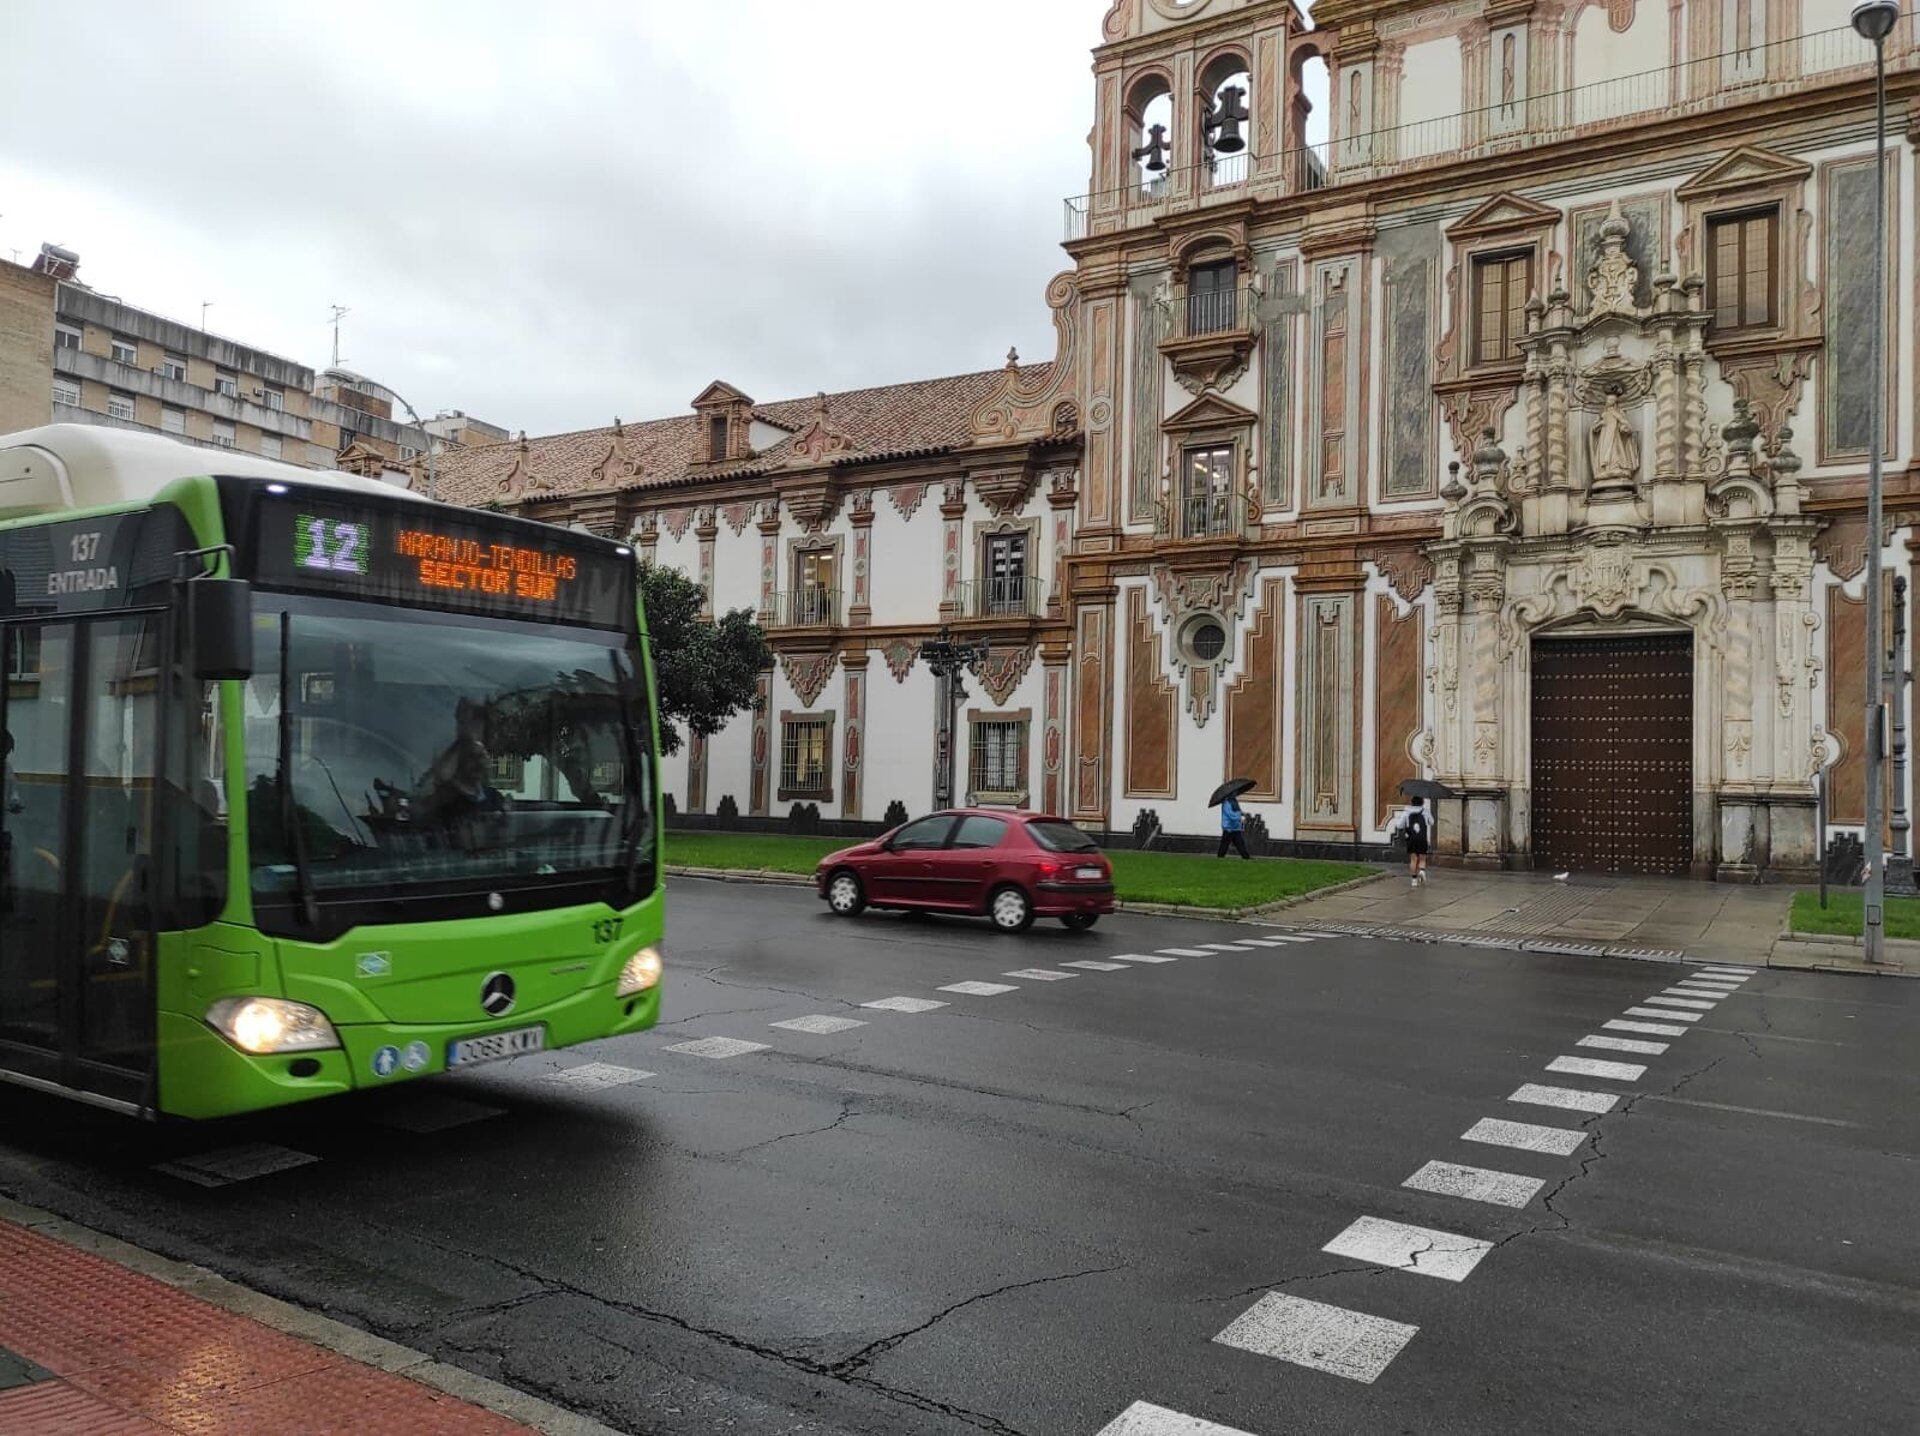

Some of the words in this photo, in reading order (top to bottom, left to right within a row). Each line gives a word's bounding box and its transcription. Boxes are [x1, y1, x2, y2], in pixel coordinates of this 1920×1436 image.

[71, 532, 101, 561] 137
[305, 519, 361, 572] 12
[48, 566, 118, 595] ENTRADA
[419, 558, 511, 595] SECTOR
[516, 573, 557, 600] SUR
[592, 917, 624, 944] 137
